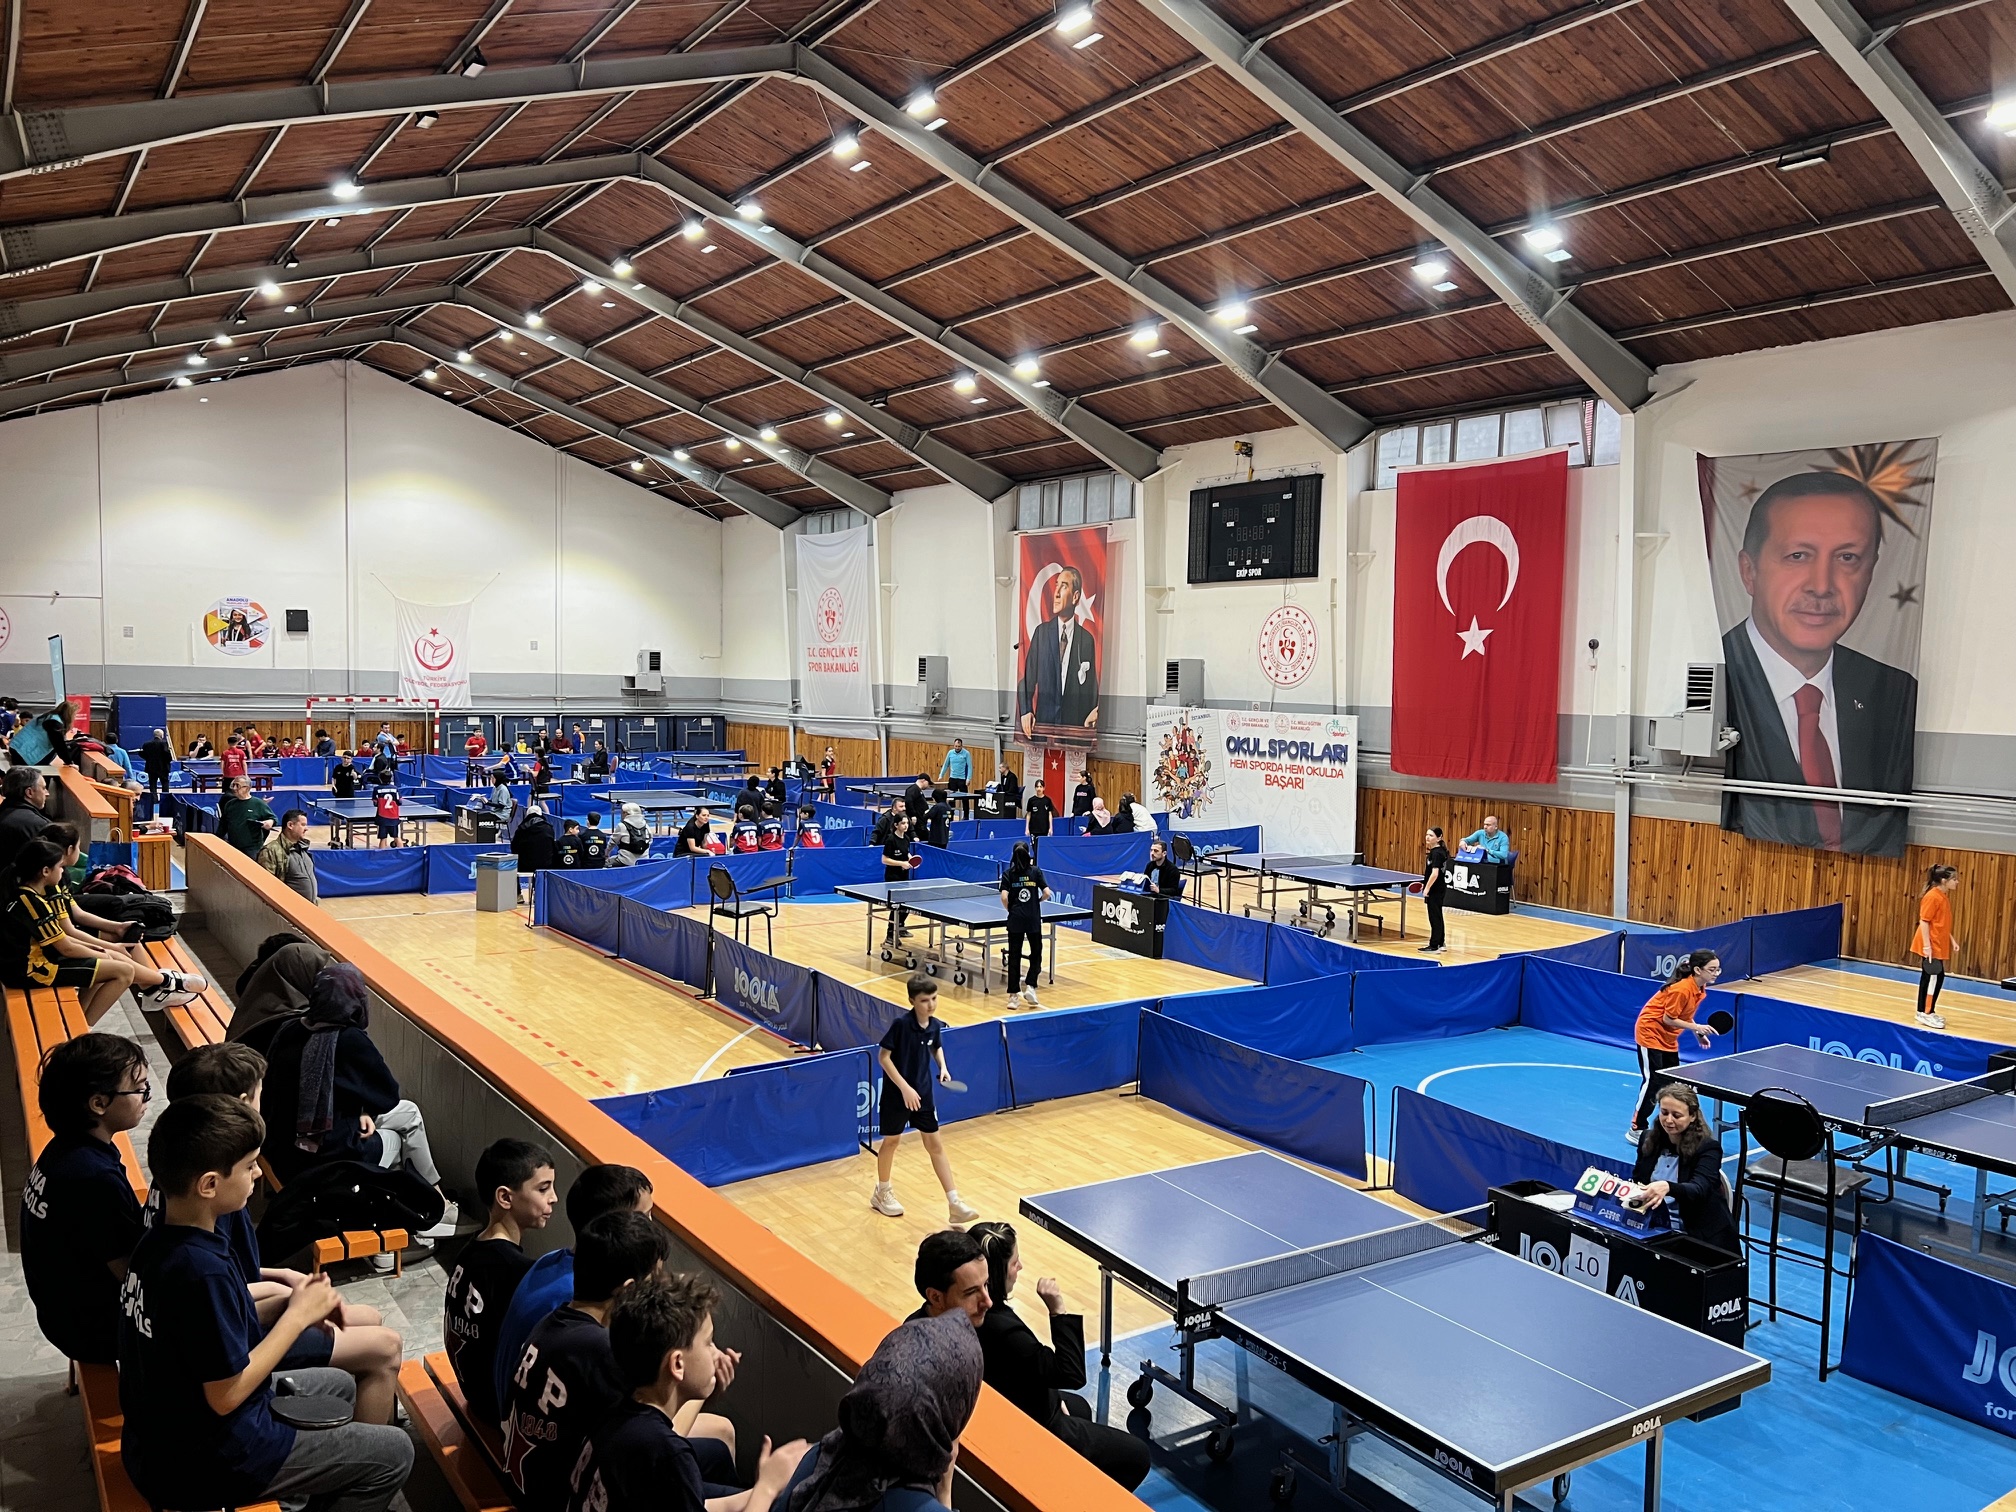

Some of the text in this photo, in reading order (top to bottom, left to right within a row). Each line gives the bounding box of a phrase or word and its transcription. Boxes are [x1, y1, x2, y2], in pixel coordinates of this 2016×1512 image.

[1248, 567, 1262, 577] SPOR
[818, 645, 846, 660] GENÇLİK
[848, 647, 858, 658] VE
[808, 660, 859, 673] SPOR BAKANLIĞI
[1226, 736, 1349, 764] OKUL SPORLARI
[1229, 758, 1344, 779] HEM SPORDA HEM OKULDA
[1264, 773, 1305, 790] BAŞARI
[383, 793, 393, 809] 2
[743, 830, 758, 846] 13
[810, 828, 821, 844] 5
[1456, 872, 1463, 881] 6
[1121, 907, 1127, 919] 7
[734, 966, 781, 1014] JOOLA
[1945, 1152, 1958, 1162] 25
[1581, 1174, 1599, 1192] 8
[1602, 1180, 1615, 1192] 0
[1617, 1185, 1631, 1197] 0
[1028, 1210, 1049, 1231] JOOLA
[1626, 1218, 1645, 1231] GUEST
[1518, 1232, 1641, 1307] JOA
[1573, 1251, 1600, 1278] 10
[1707, 1297, 1742, 1320] JOOLA
[454, 1315, 480, 1339] 1948
[1184, 1311, 1212, 1328] JOOLA
[1984, 1401, 2016, 1421] for
[1632, 1415, 1662, 1437] JOOLA
[1434, 1448, 1474, 1481] JOOLA
